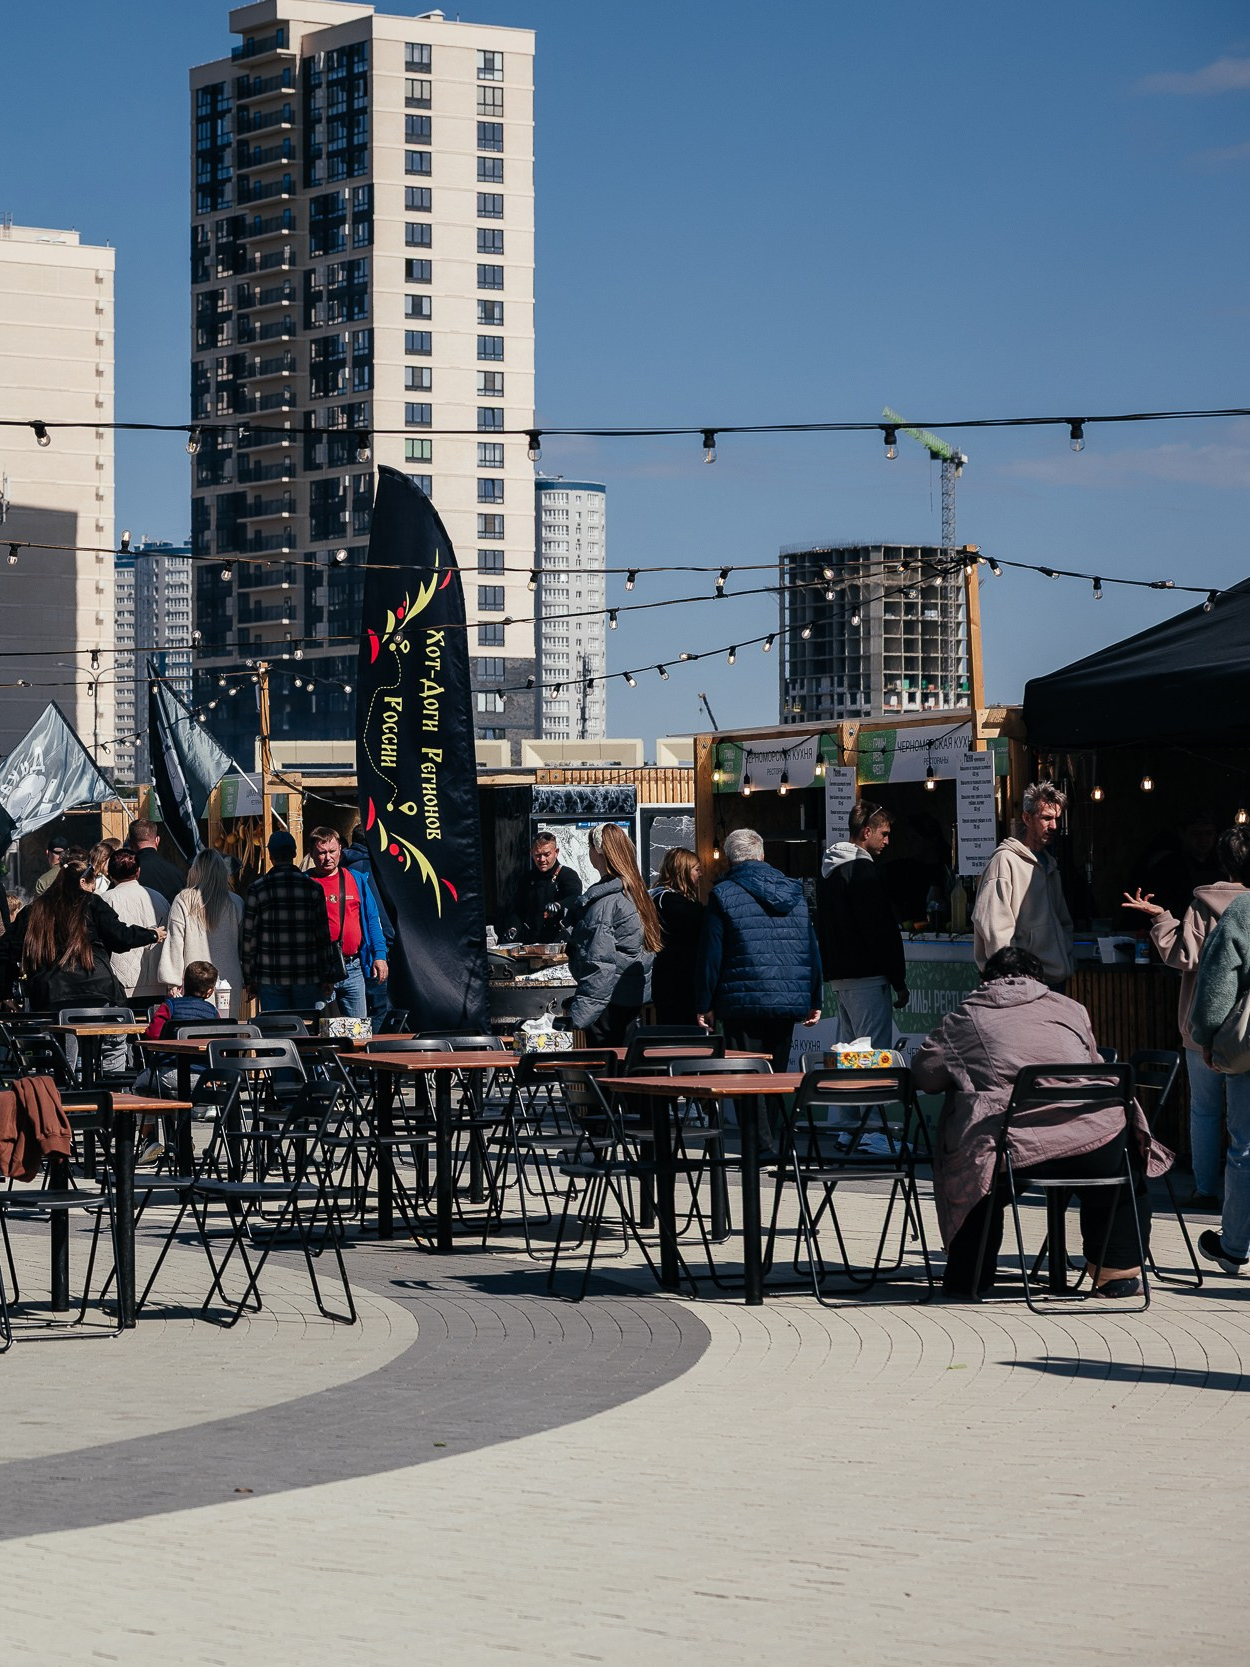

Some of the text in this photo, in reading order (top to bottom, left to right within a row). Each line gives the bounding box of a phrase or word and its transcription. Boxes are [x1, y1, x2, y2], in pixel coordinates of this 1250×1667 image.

[897, 736, 953, 753] ЧЕРНОМОСКАЯ
[745, 747, 813, 764] ЕРНОМОРСКЯ КУХНЯ
[766, 767, 789, 776] РЕСТОРАЫ
[901, 989, 932, 1014] РИЛЬ!
